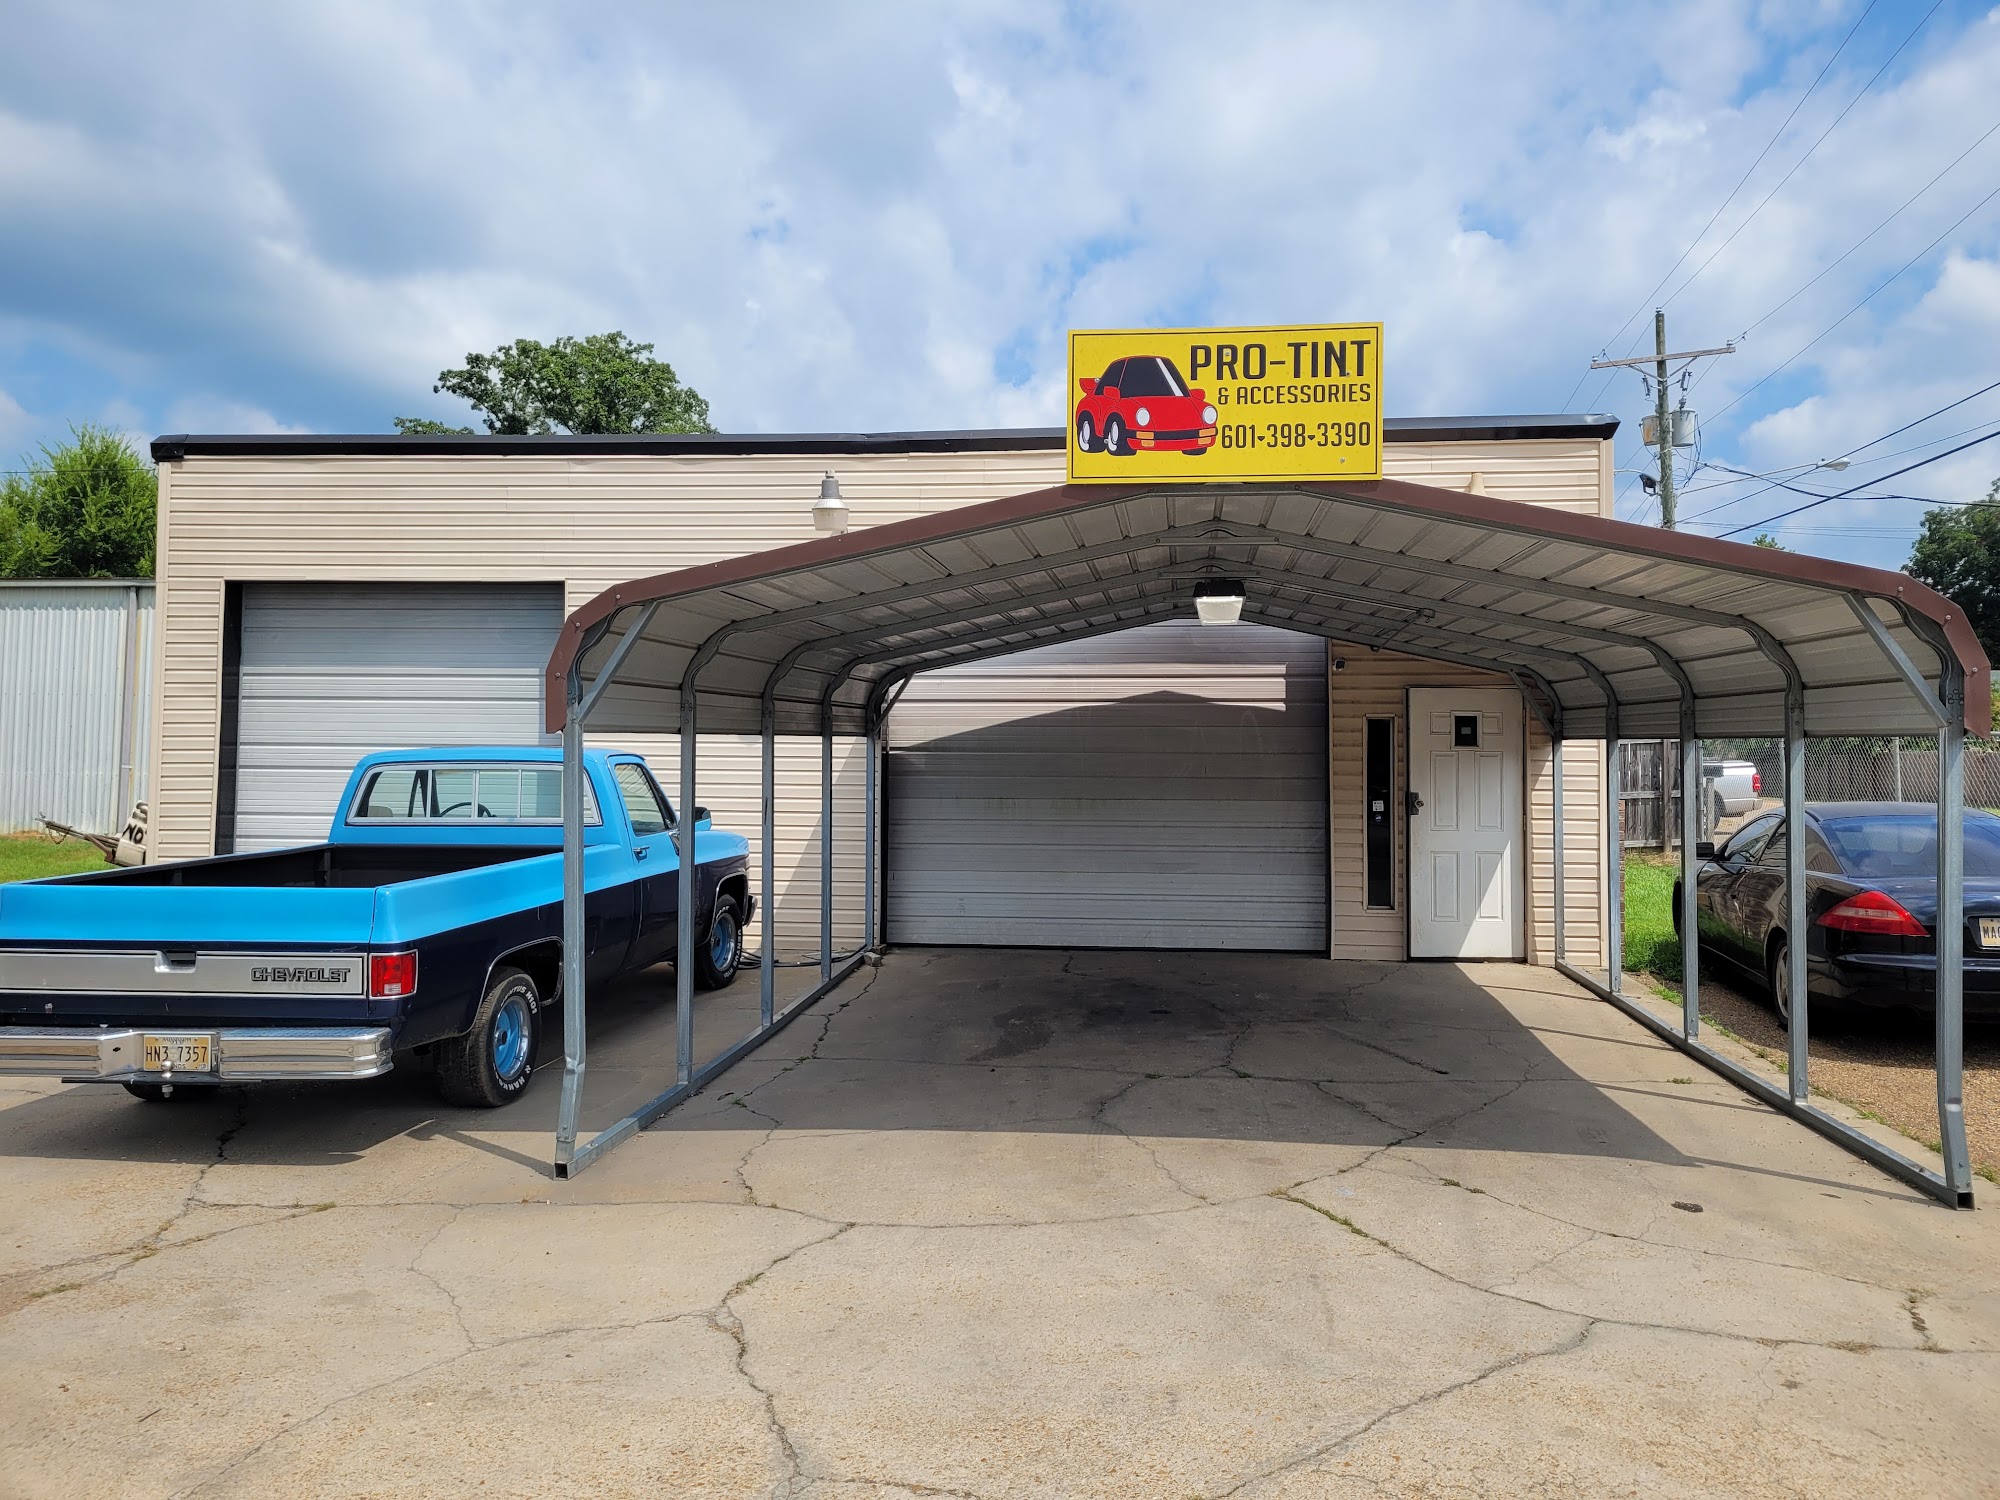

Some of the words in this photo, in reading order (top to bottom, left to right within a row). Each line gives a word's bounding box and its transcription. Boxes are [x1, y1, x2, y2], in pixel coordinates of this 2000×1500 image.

[1190, 340, 1371, 381] PRO-TINT
[1217, 386, 1230, 405] &
[1236, 383, 1371, 405] ACCESSORIES
[1221, 421, 1371, 449] 601-398-3390
[251, 967, 350, 983] CHEVROLET
[177, 1046, 208, 1063] 7357
